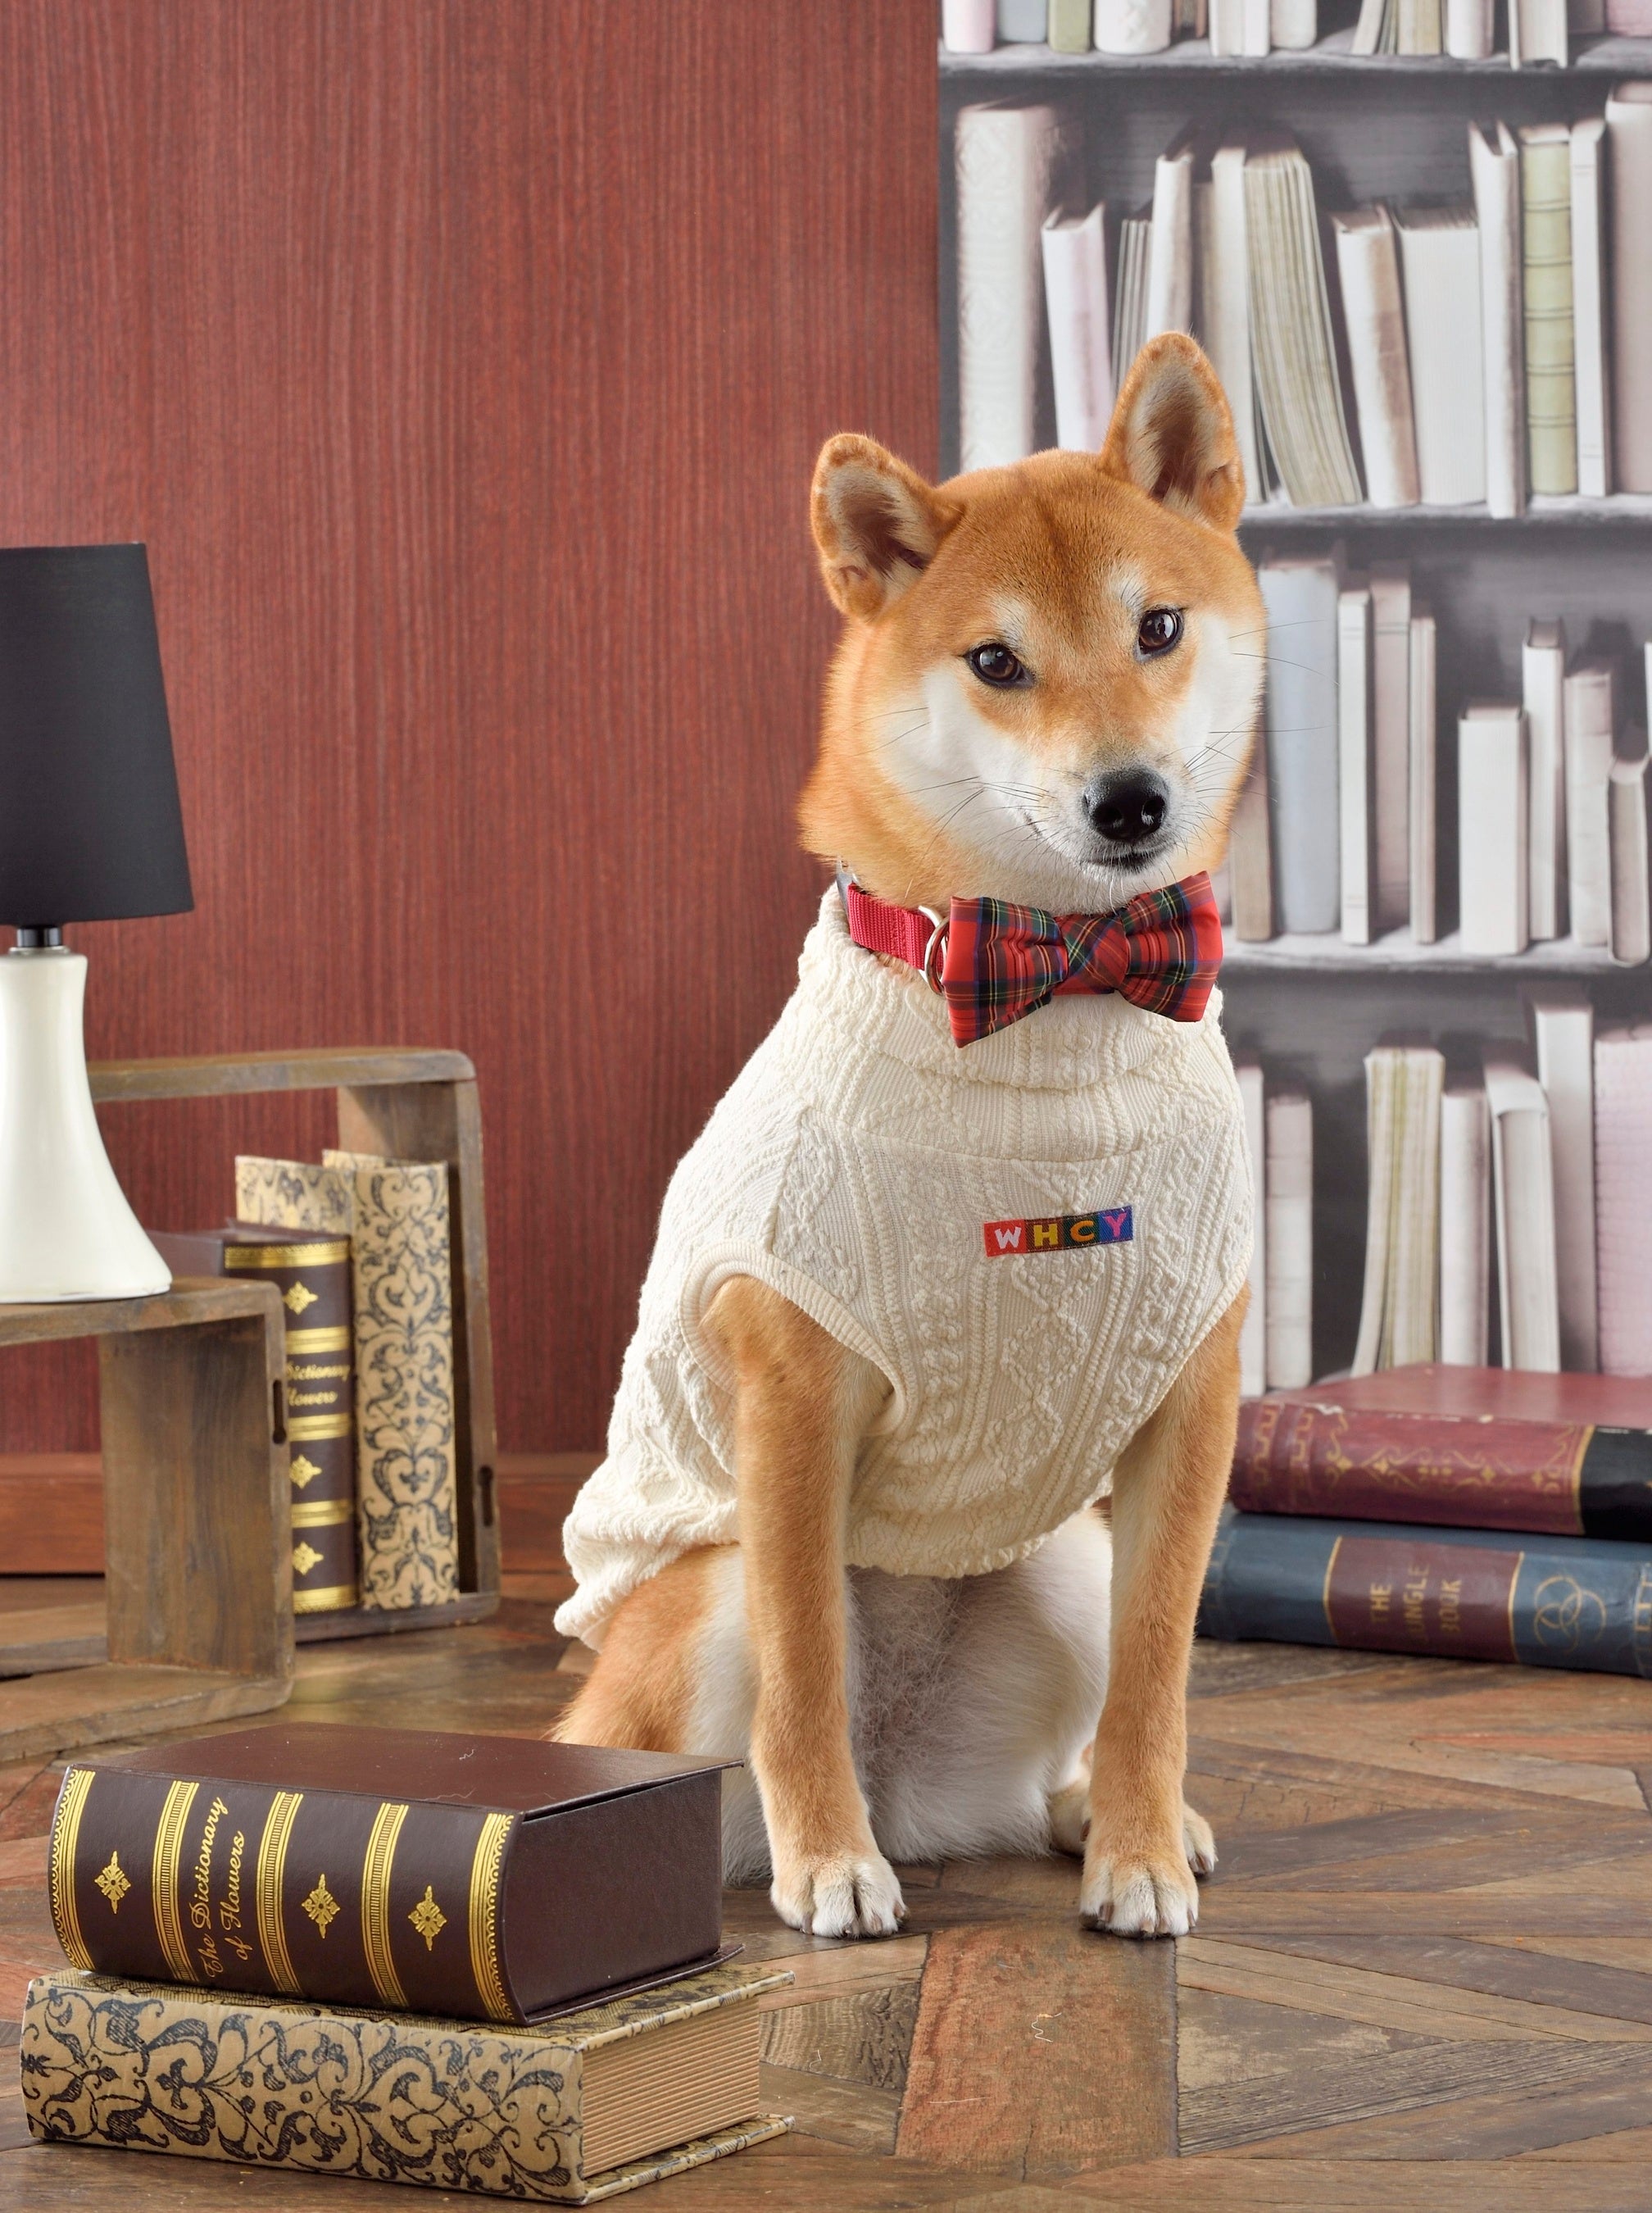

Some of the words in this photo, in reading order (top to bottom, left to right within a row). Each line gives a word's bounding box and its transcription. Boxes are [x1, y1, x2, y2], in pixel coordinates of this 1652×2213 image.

[994, 1212, 1127, 1250] WHCY
[288, 1387, 338, 1406] lowers
[1369, 1582, 1392, 1625] THE
[1439, 1579, 1463, 1634] BOOK
[188, 1797, 229, 1929] Dictionary
[220, 1830, 245, 1930] Flowers
[197, 1934, 224, 1979] The
[224, 1936, 252, 1961] of
